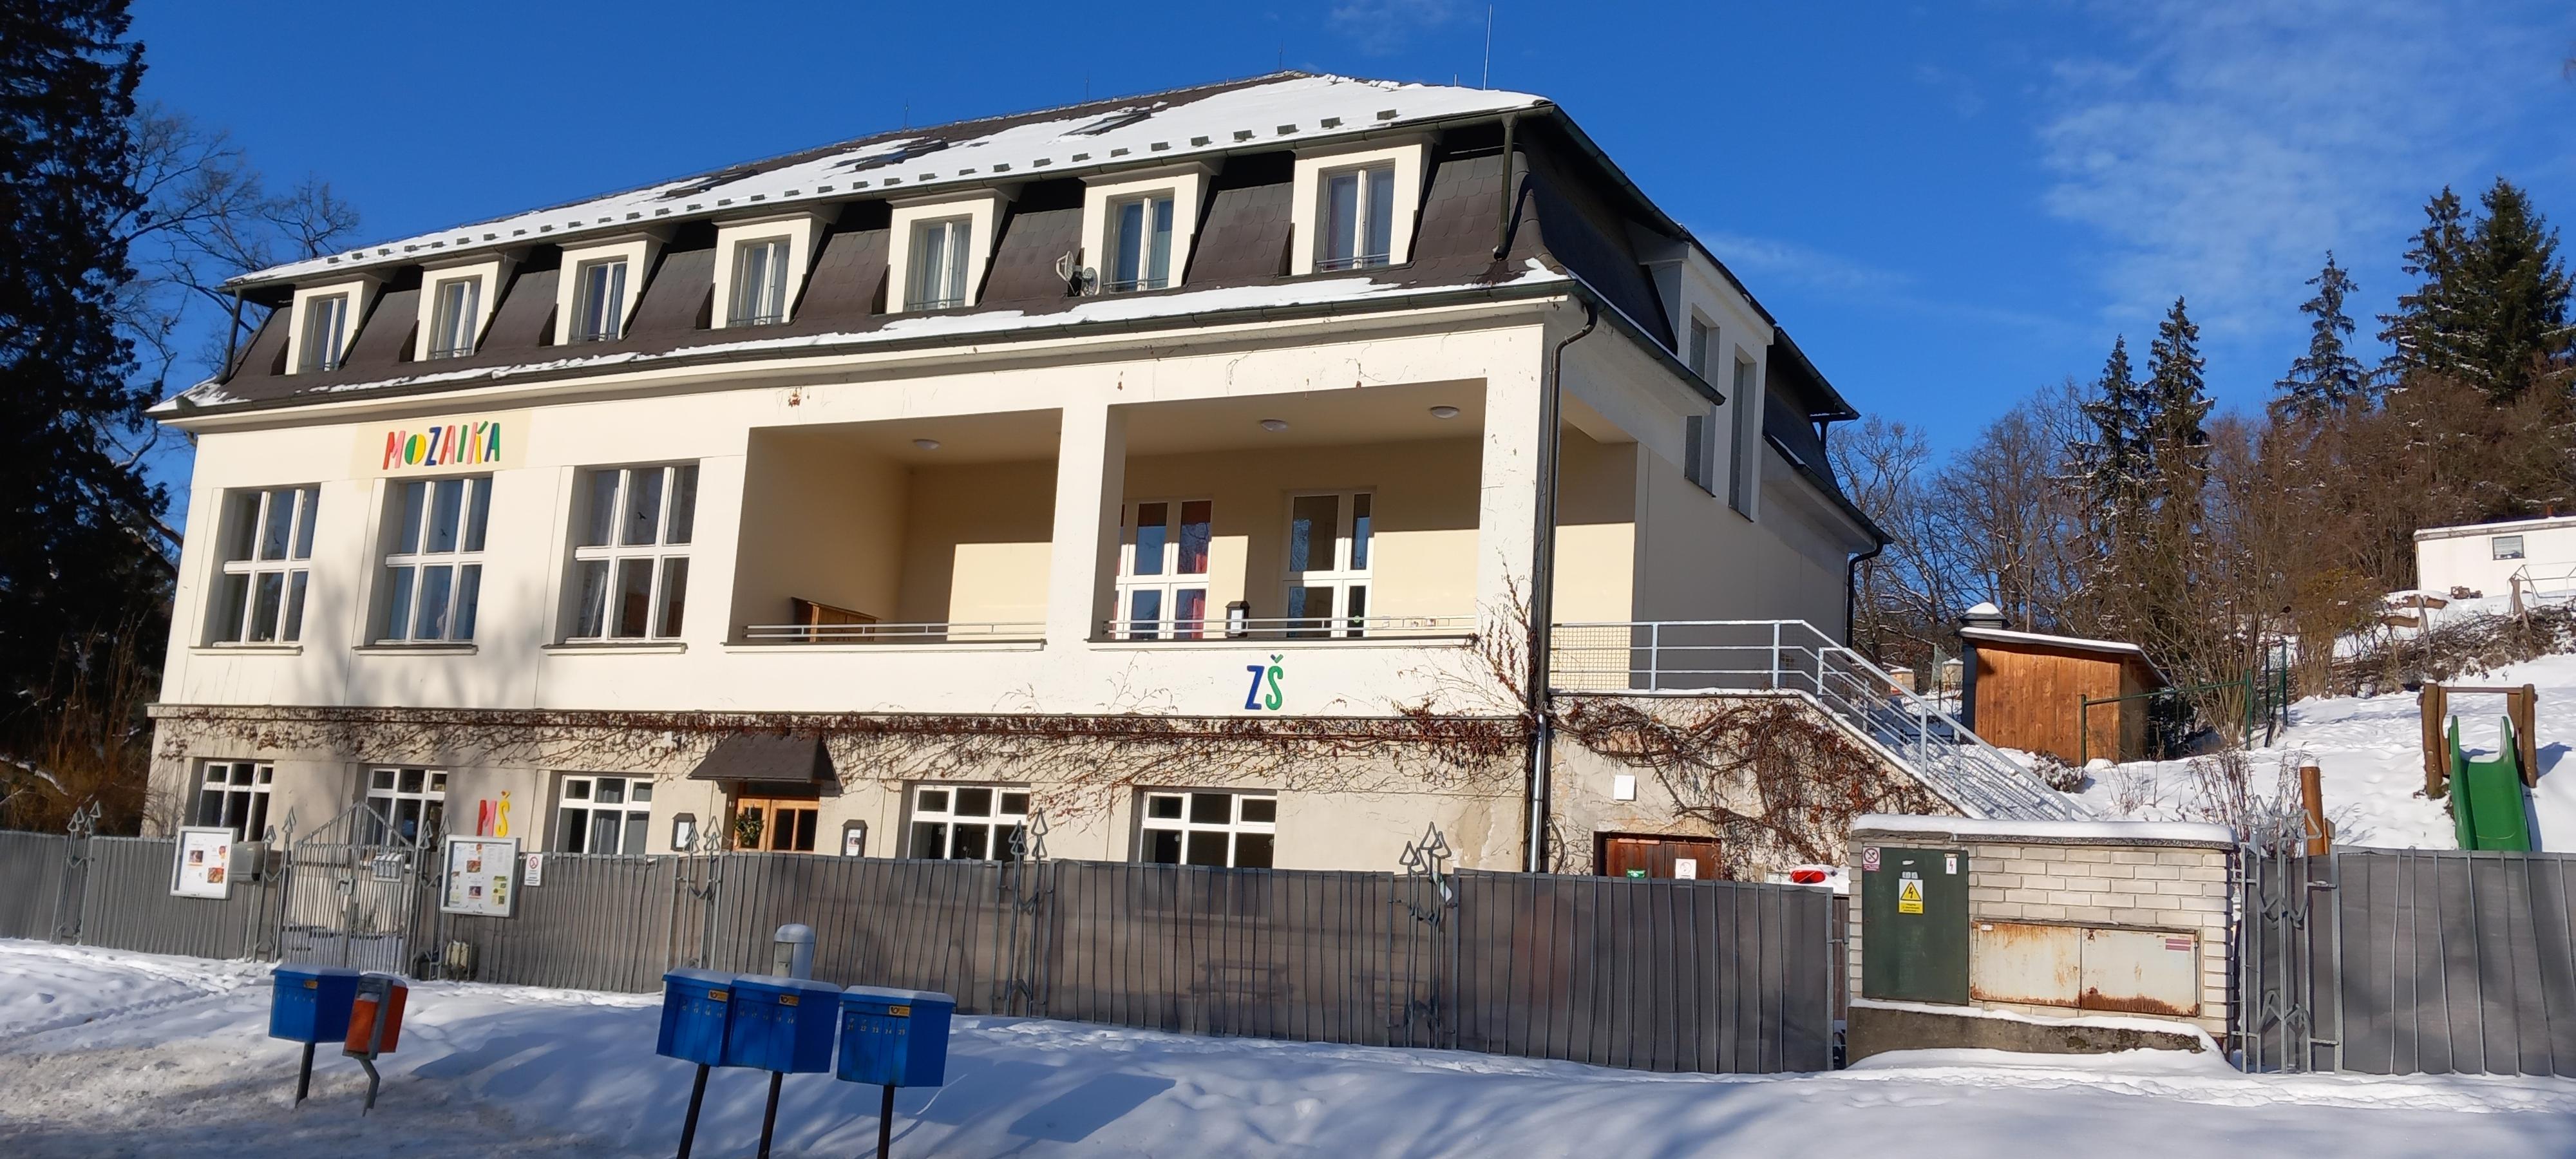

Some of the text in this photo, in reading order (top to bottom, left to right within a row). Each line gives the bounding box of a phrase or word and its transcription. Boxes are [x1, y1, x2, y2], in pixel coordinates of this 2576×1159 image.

[383, 420, 500, 470] MOZAIKA
[1244, 654, 1283, 711] ZŠ
[476, 790, 511, 838] MŠ
